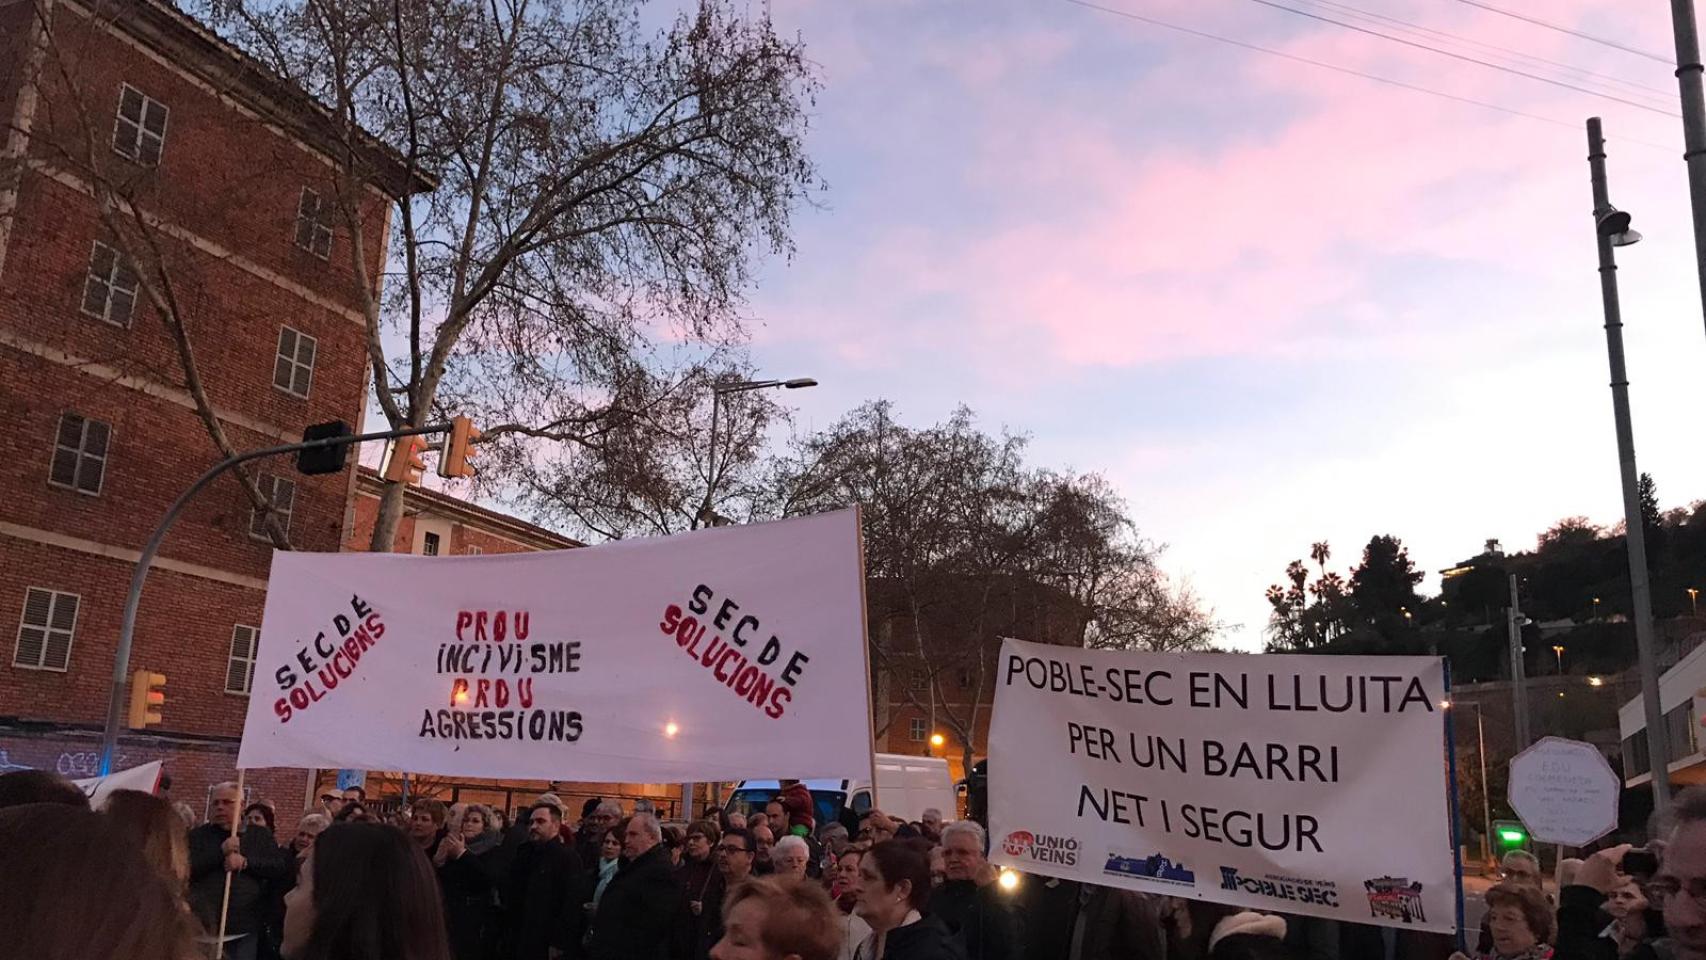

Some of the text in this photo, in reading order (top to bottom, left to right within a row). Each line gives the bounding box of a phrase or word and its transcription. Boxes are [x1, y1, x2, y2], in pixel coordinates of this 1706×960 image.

[275, 593, 373, 690] SEC DE
[456, 611, 530, 642] PROU
[689, 584, 810, 687] SEC DE
[274, 613, 386, 723] SOLUCIONS
[659, 604, 792, 719] SOLUCIONS
[1006, 655, 1435, 713] POBLE-SEC EN LLUITA
[450, 677, 533, 709] PROU
[1067, 722, 1339, 782] PER UN BARRI
[1036, 834, 1078, 850] UNIÓ
[1077, 785, 1325, 853] NET I SEGUR
[1296, 884, 1340, 908] SEC
